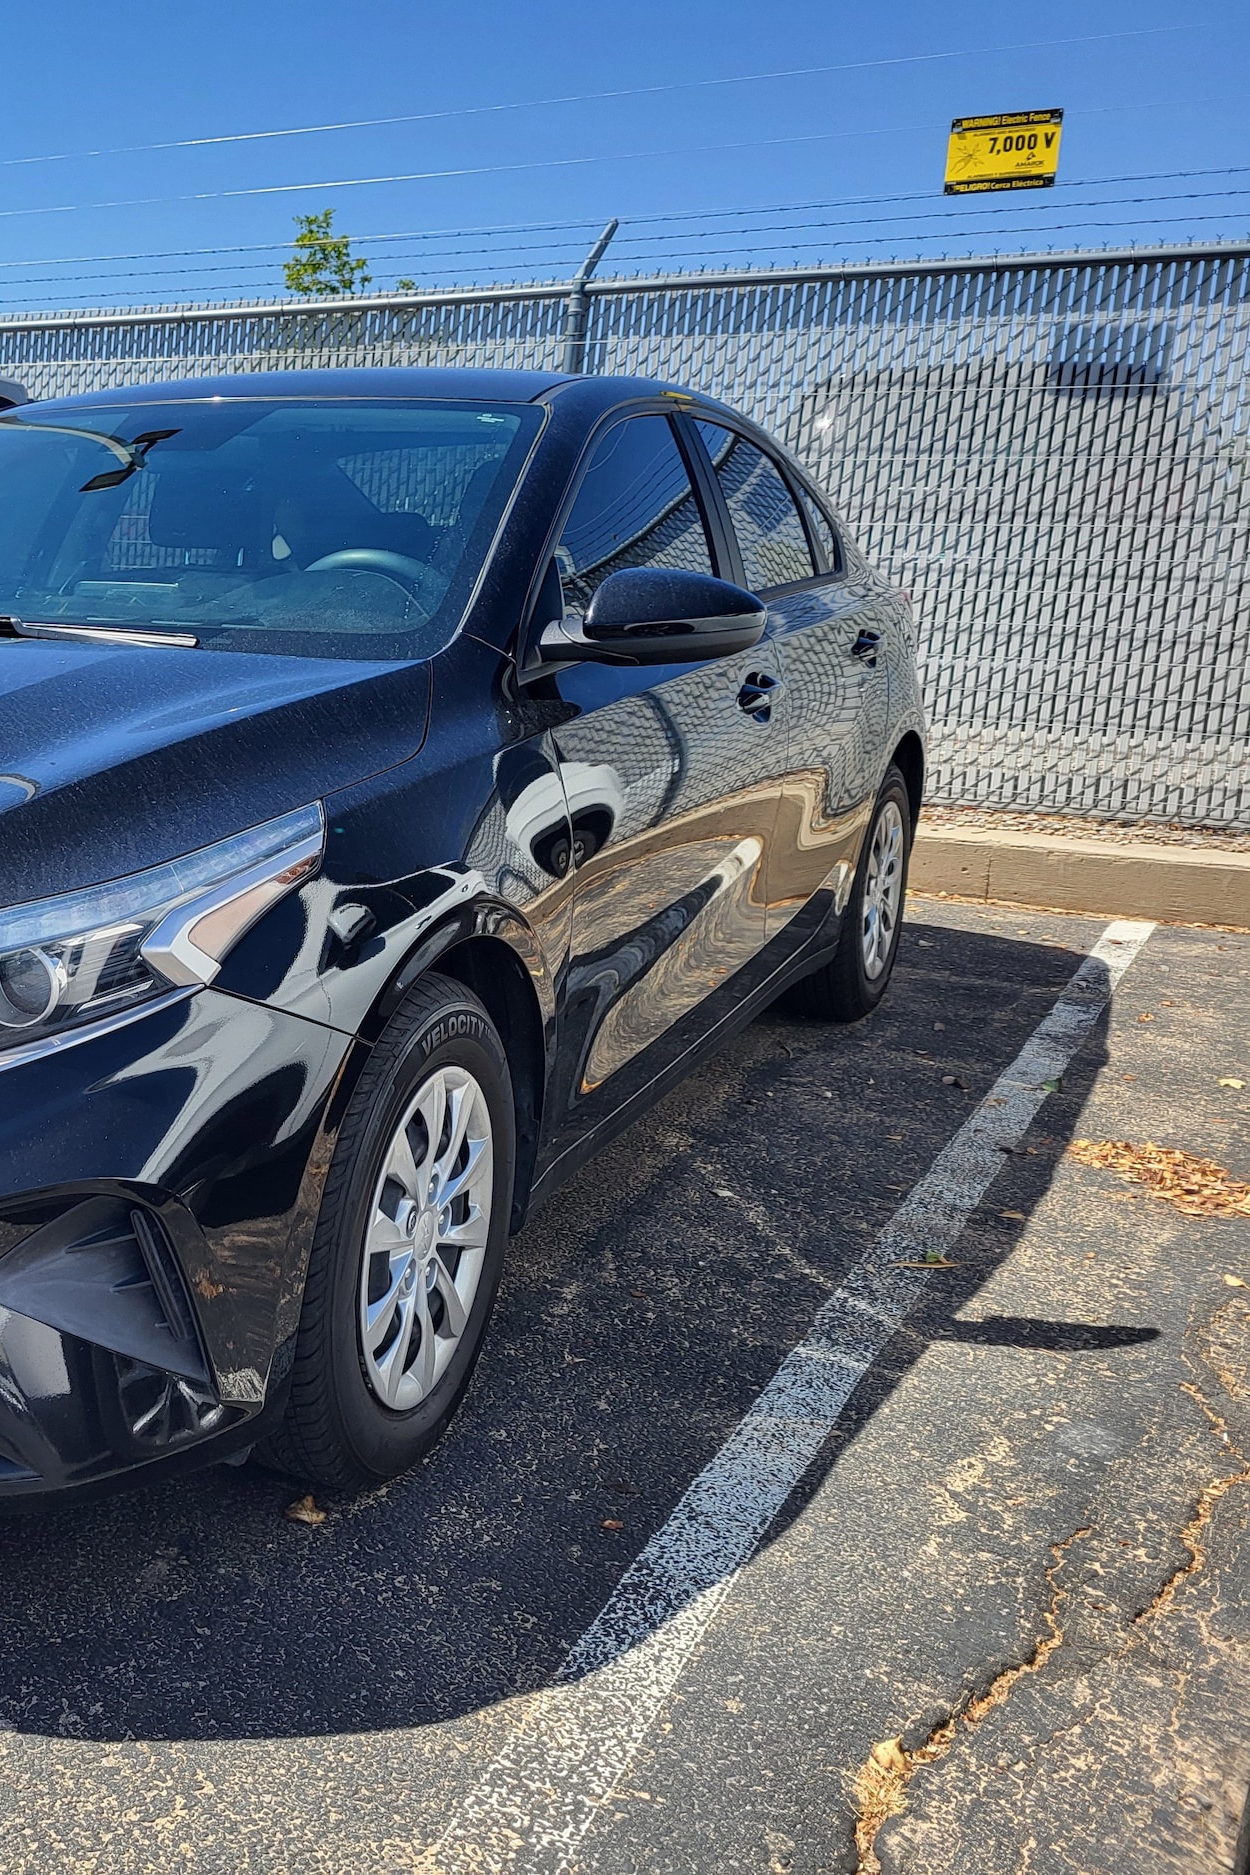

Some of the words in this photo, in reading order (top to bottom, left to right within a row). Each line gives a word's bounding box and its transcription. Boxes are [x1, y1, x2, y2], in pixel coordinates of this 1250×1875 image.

[988, 133, 1038, 155] 7,000
[1044, 131, 1057, 149] V
[421, 1014, 485, 1057] VELOCITY
